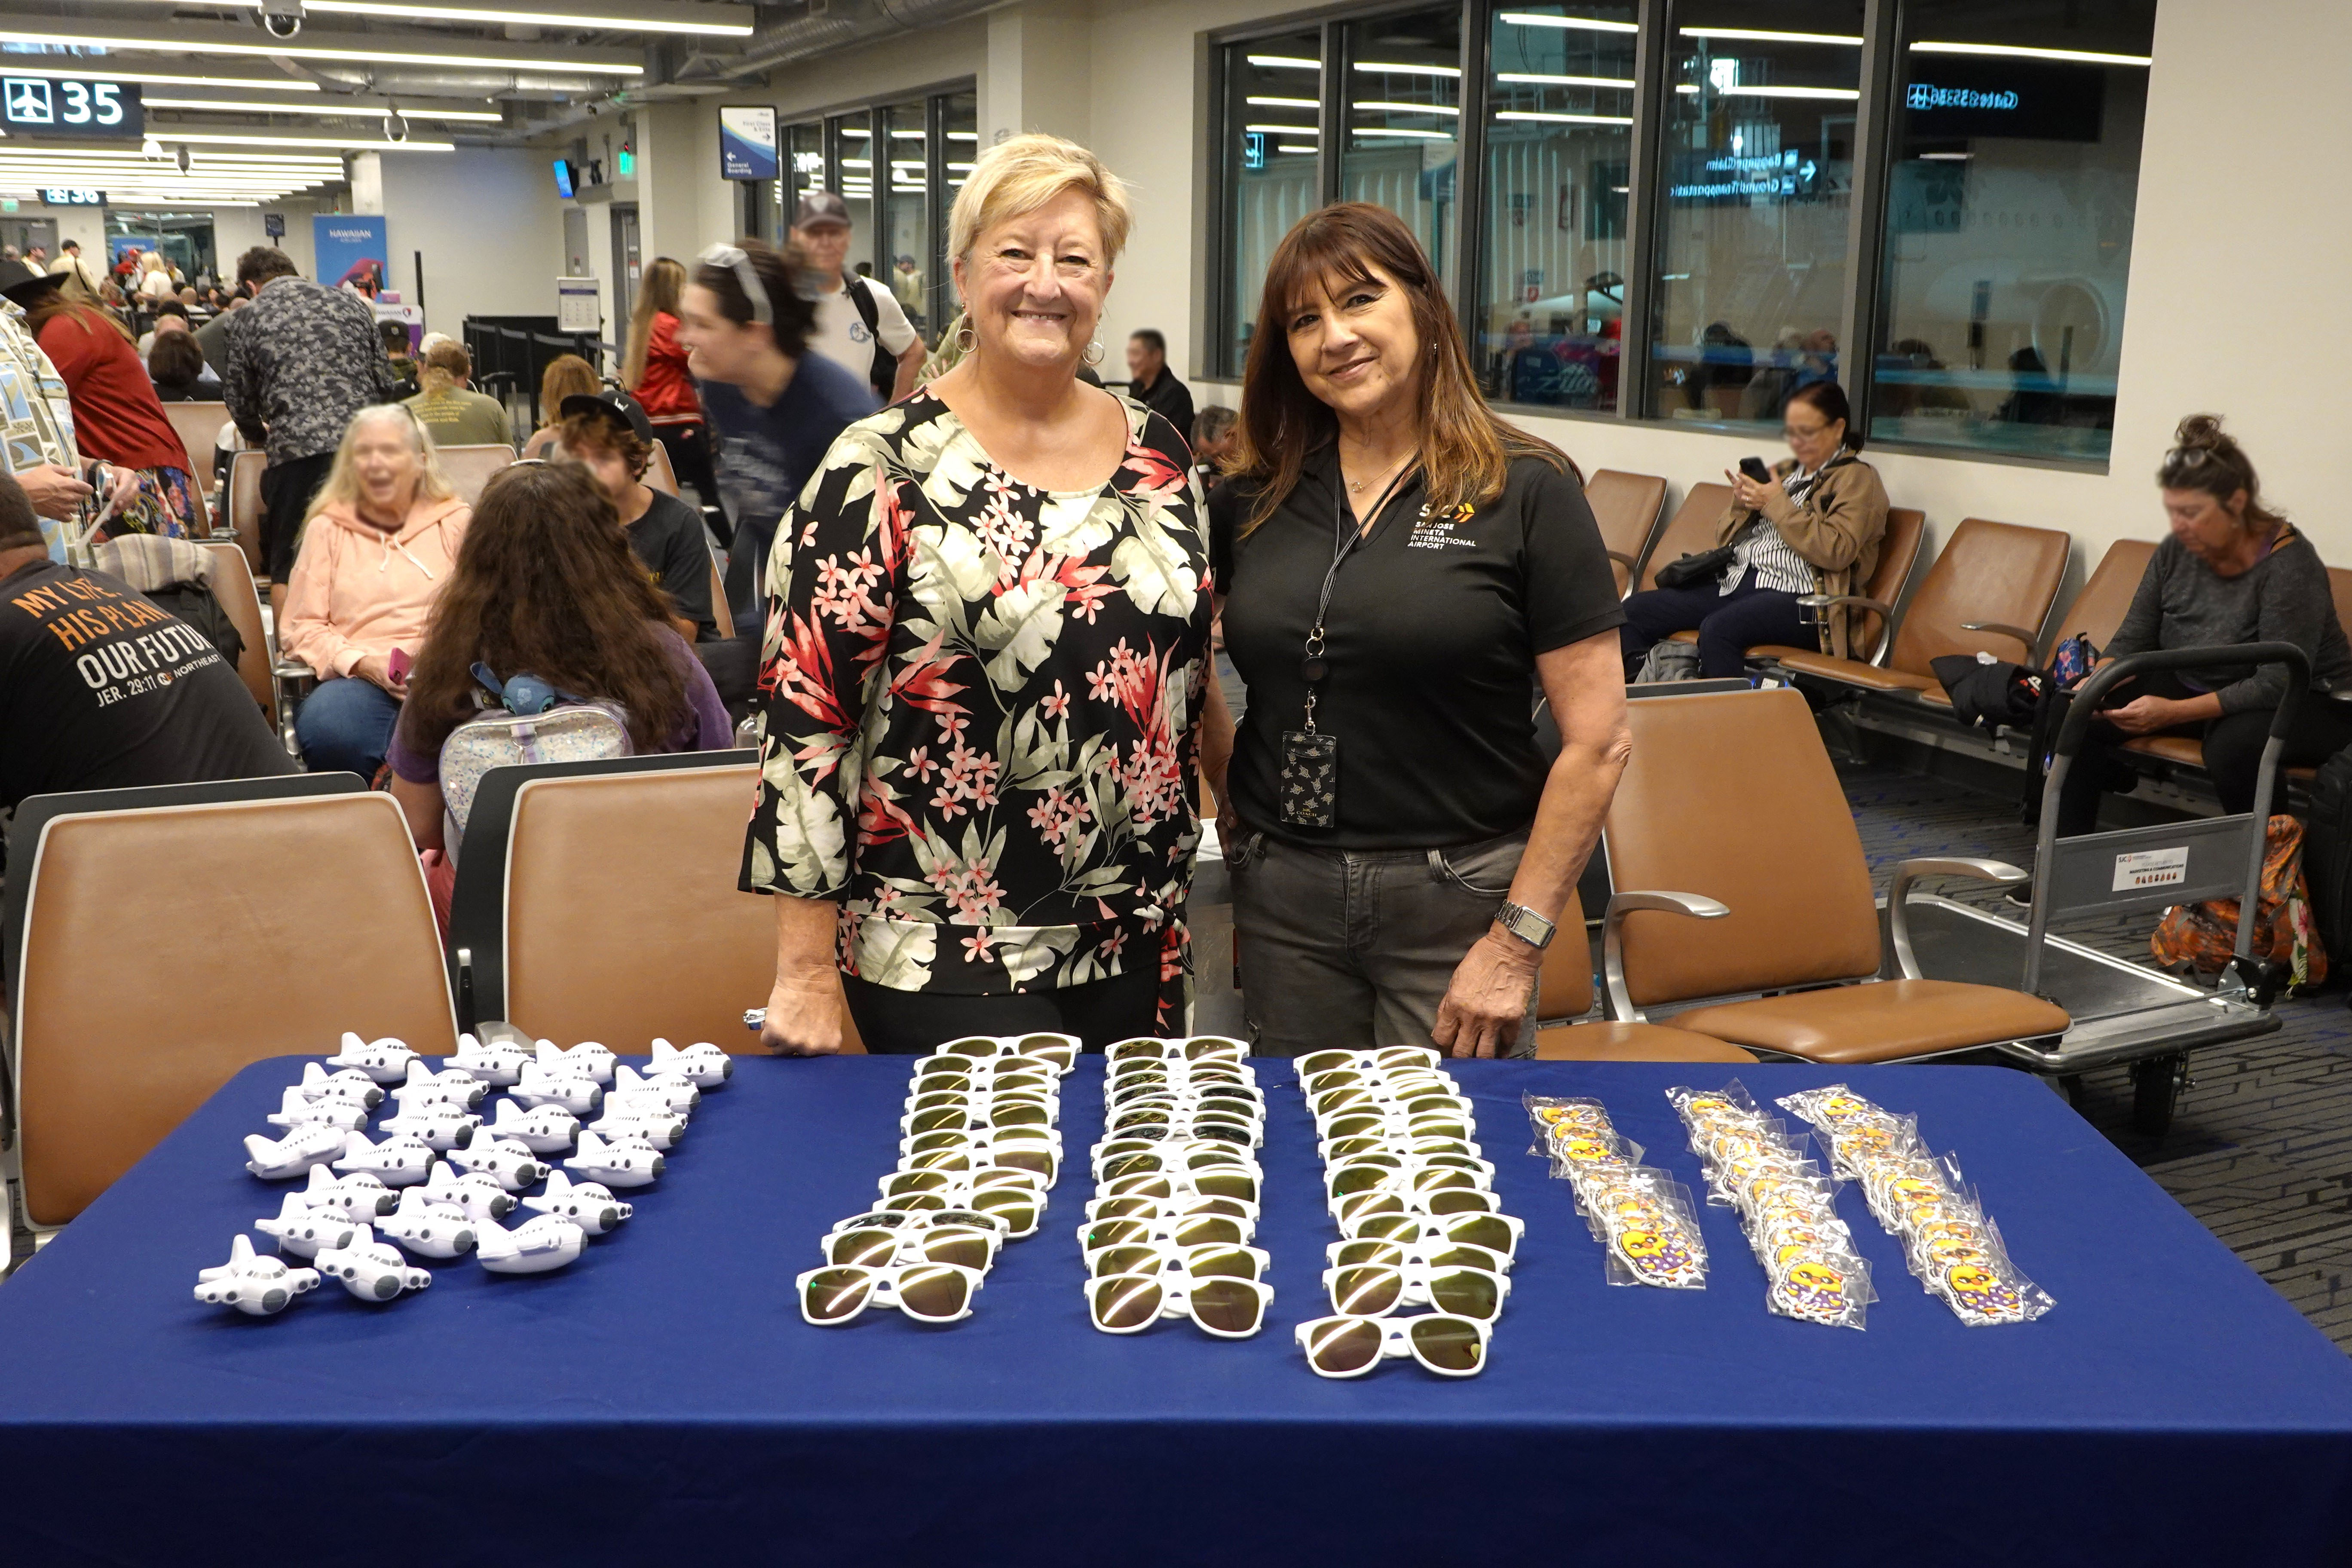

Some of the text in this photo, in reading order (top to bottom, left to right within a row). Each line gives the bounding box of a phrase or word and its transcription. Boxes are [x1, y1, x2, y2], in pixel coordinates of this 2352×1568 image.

[62, 82, 122, 124] 35
[329, 229, 372, 239] HAWAIIAN
[1419, 503, 1452, 518] SC
[1407, 541, 1444, 550] AIRPORT
[1411, 534, 1476, 546] INTERNATIONAL
[11, 585, 69, 619] MY
[47, 609, 110, 652] HIS
[77, 641, 148, 689] OUR
[96, 686, 127, 707] JER.
[127, 674, 157, 696] 29:11
[173, 654, 220, 678] NORTHEAST
